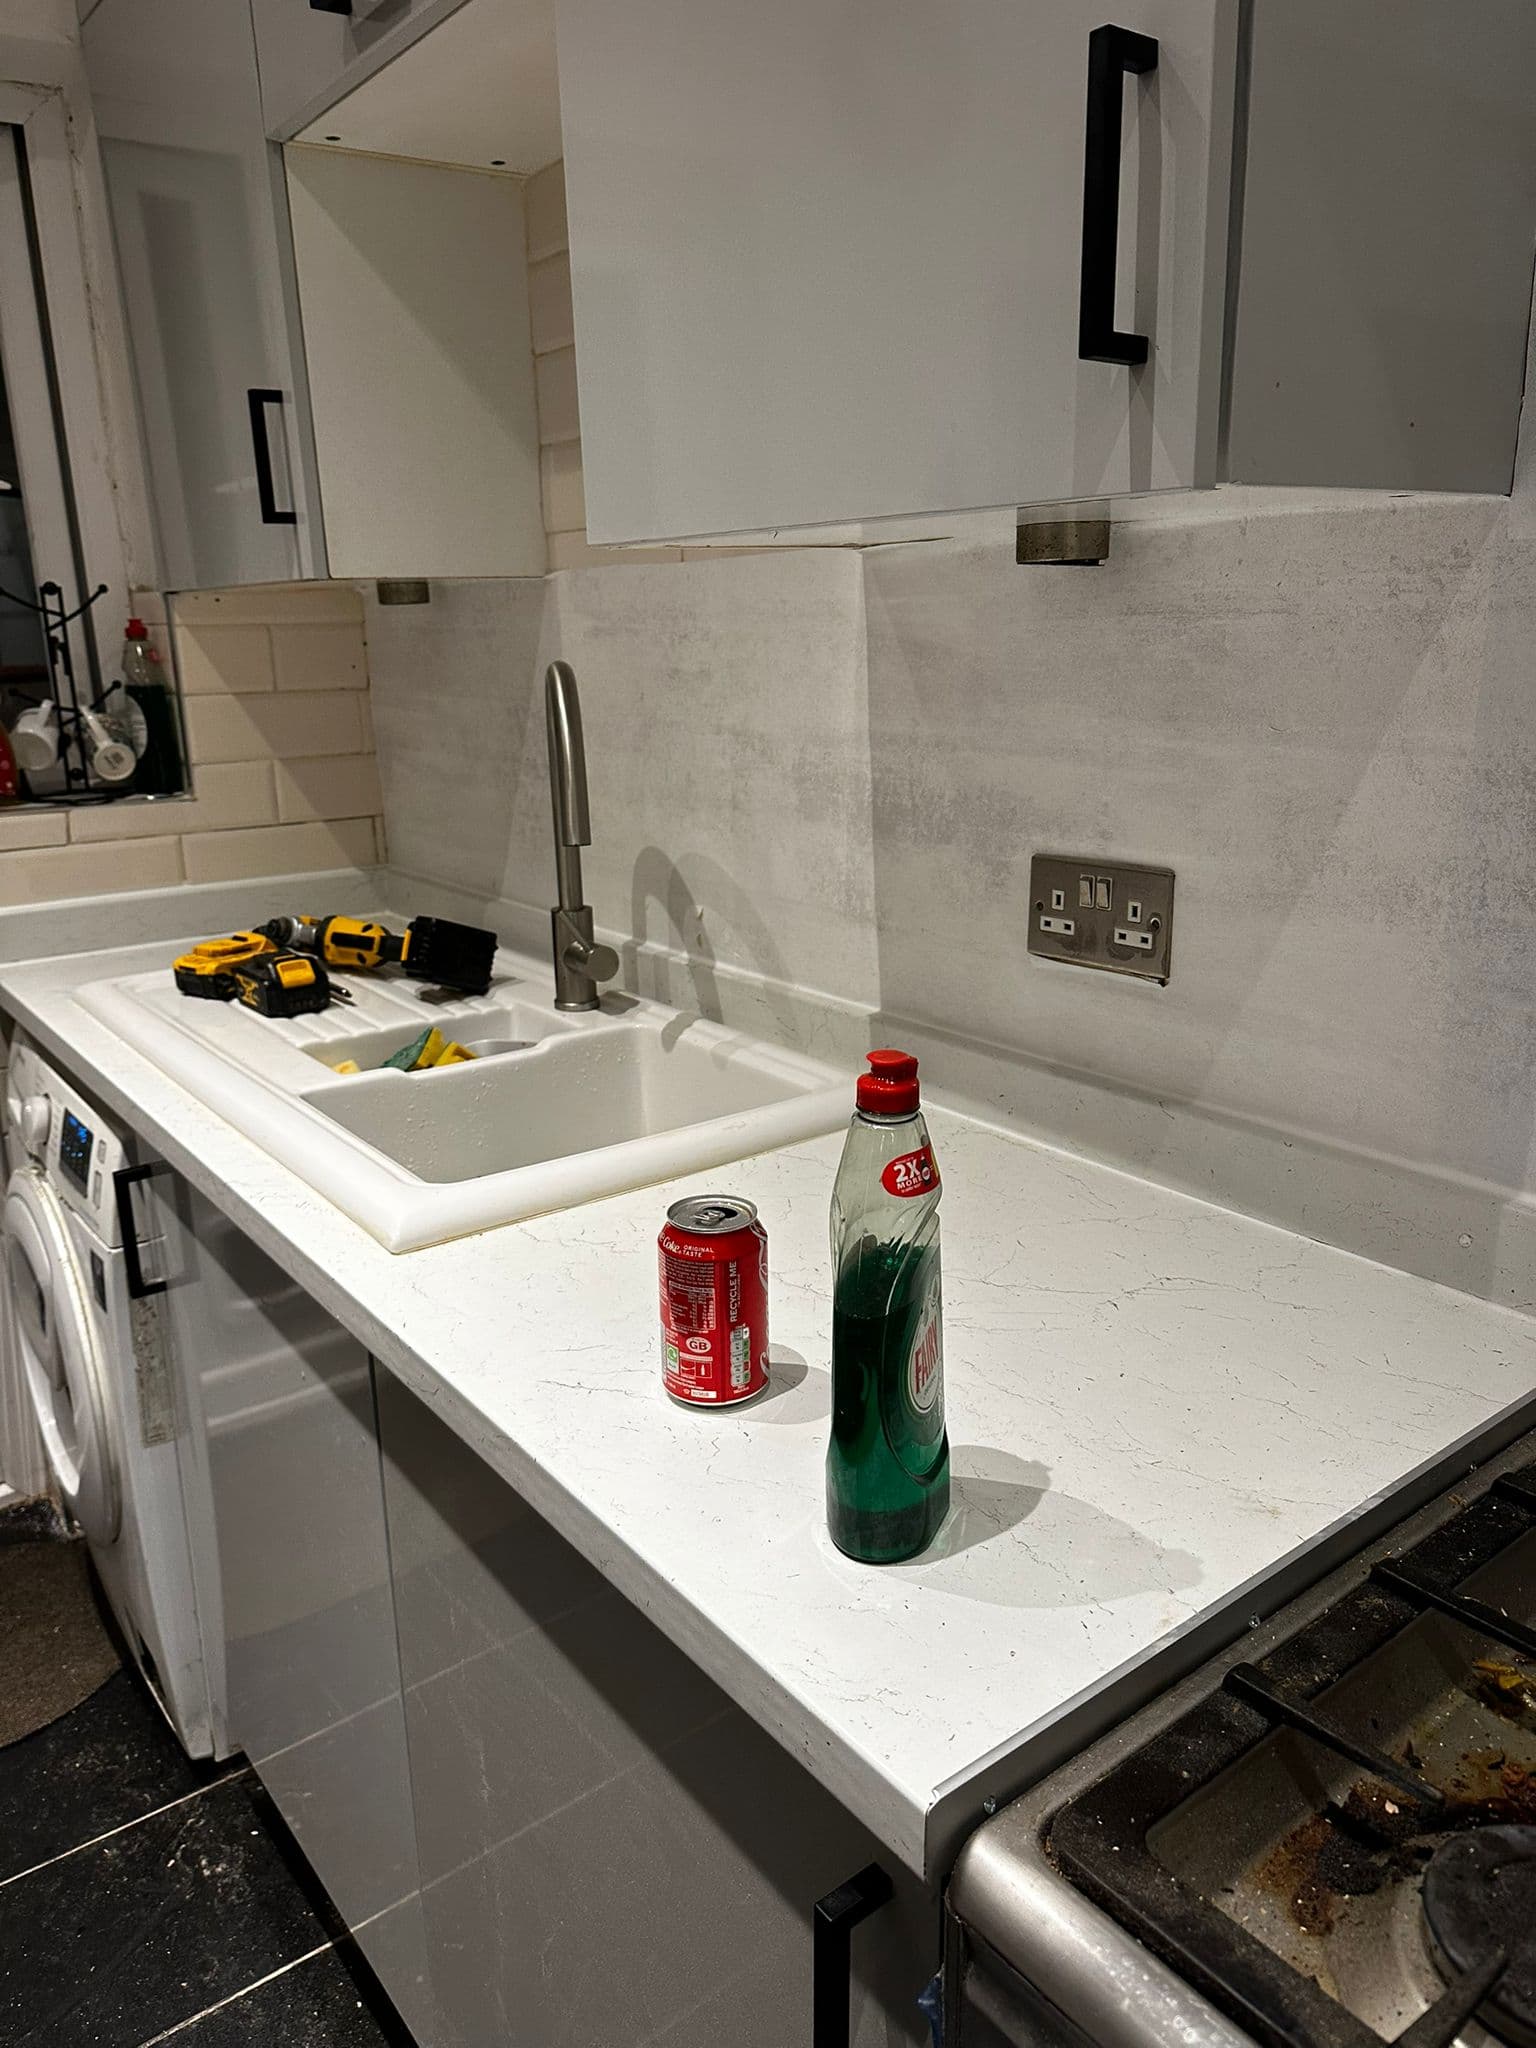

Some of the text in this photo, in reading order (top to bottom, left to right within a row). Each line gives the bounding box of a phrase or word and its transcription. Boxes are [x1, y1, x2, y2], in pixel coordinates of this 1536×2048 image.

[893, 1159, 920, 1183] 2X
[896, 1176, 923, 1190] MORE
[663, 1236, 680, 1253] Coke
[683, 1244, 715, 1253] ORIGINAL
[682, 1250, 702, 1258] TASTE
[729, 1261, 738, 1278] ME
[729, 1279, 738, 1322] RECYCLE
[689, 1340, 708, 1351] GB
